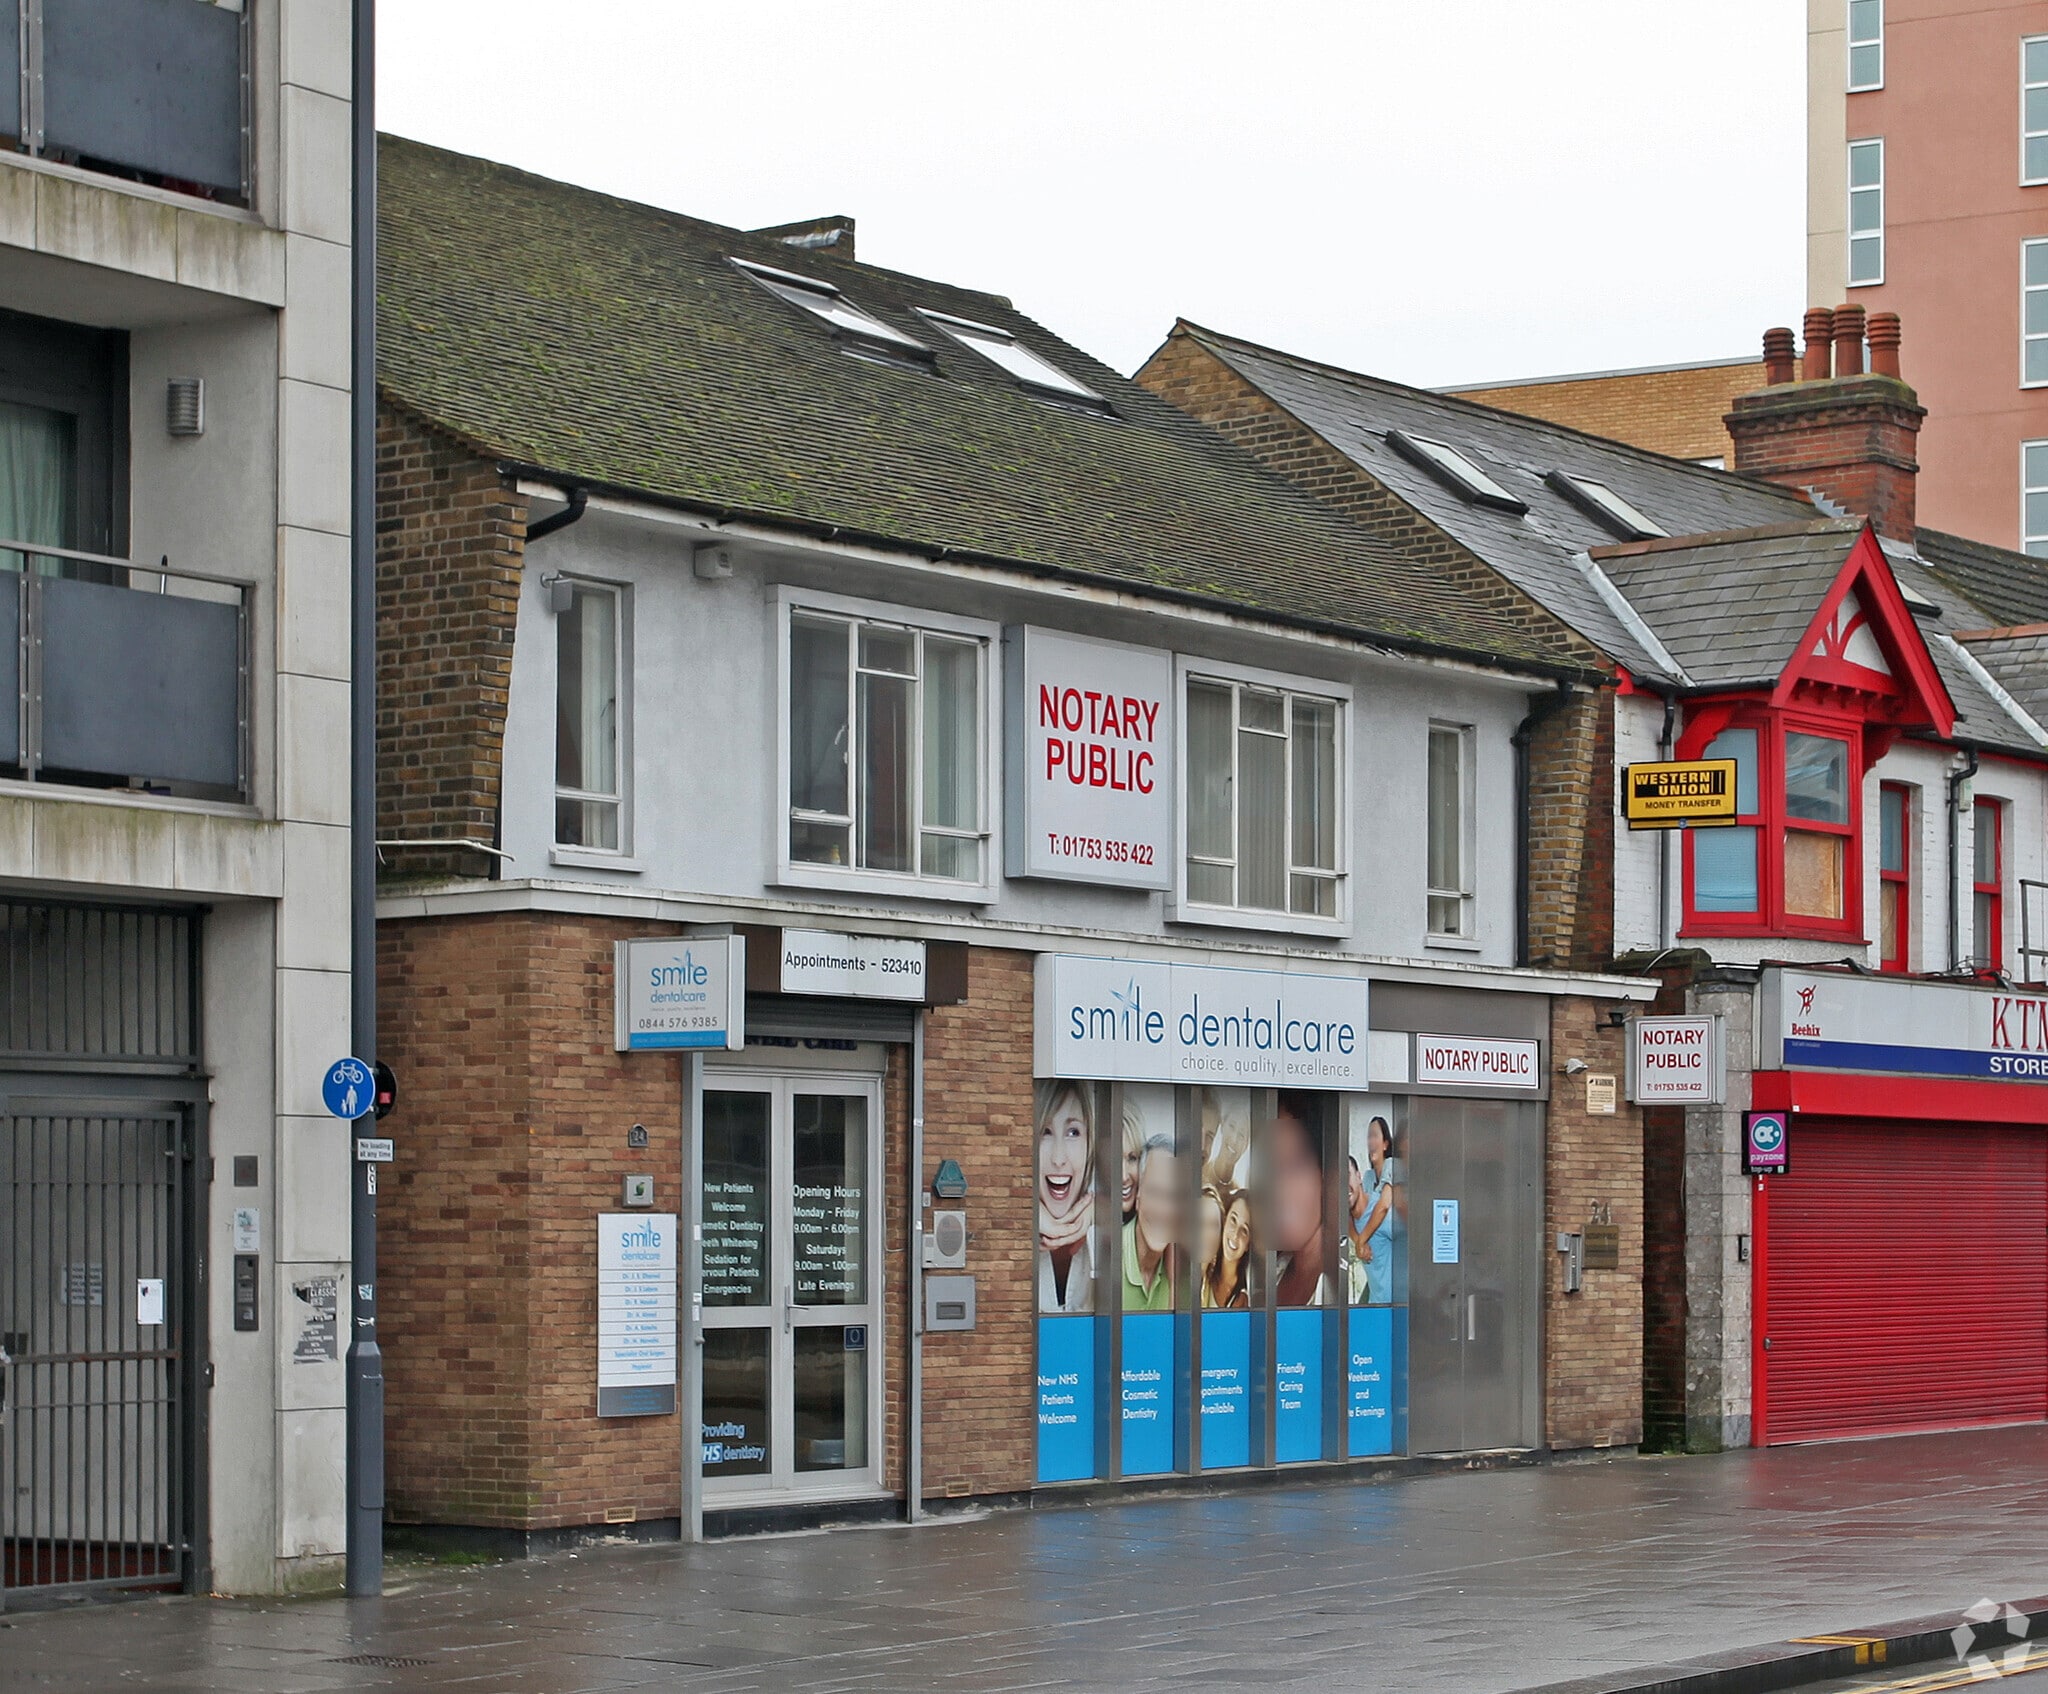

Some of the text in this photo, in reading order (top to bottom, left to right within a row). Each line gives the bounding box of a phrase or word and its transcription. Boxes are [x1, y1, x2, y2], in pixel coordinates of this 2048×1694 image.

[1040, 684, 1160, 743] NOTARY
[1046, 738, 1154, 795] PUBLIC
[1635, 771, 1710, 785] WESTERN
[1658, 783, 1710, 796] UNION
[1645, 799, 1722, 809] MONEY TRANSFER
[1048, 833, 1153, 866] T: 01753 535 422
[651, 950, 708, 987] smile
[785, 951, 866, 971] Appointments
[881, 958, 922, 976] 523410
[650, 989, 706, 1003] dentalcare
[639, 1016, 718, 1029] 0844 576 9385
[1070, 986, 1355, 1055] smile dentalcare
[1643, 1029, 1704, 1045] NOTARY
[1182, 1052, 1228, 1071] choice.
[1287, 1059, 1354, 1077] excellence.
[1425, 1048, 1529, 1074] NOTARY PUBLIC
[1646, 1053, 1702, 1068] PUBLIC
[1654, 1083, 1674, 1091] 01753
[1676, 1083, 1688, 1091] 535
[1690, 1083, 1702, 1091] 422
[1751, 1154, 1784, 1163] payzone
[704, 1182, 754, 1193] New Patients
[793, 1184, 861, 1200] Opening Hours
[711, 1201, 747, 1212] Welcome
[793, 1207, 825, 1219] Monday
[835, 1206, 859, 1220] Friday
[730, 1220, 764, 1232] Dentistry
[622, 1219, 661, 1248] smile
[701, 1237, 758, 1249] eeth Whitening
[806, 1244, 848, 1256] Saturdays
[704, 1254, 752, 1264] Sedation for
[729, 1267, 759, 1277] Patients
[704, 1284, 752, 1295] Emergencies
[798, 1280, 855, 1292] Late Evenings
[1353, 1354, 1372, 1366] Open
[1201, 1368, 1239, 1379] mergency
[1277, 1362, 1306, 1375] Friendly
[1038, 1373, 1079, 1386] New NHS
[1122, 1388, 1159, 1400] Cosmetic
[1279, 1381, 1304, 1394] Caring
[1355, 1388, 1369, 1400] and
[1042, 1394, 1074, 1405] Patients
[1280, 1399, 1302, 1409] Team
[1123, 1408, 1158, 1420] Dentistry
[1200, 1402, 1235, 1414] Available
[1355, 1405, 1386, 1418] Evenings
[1039, 1412, 1078, 1424] Welcome
[702, 1445, 766, 1462] HS dentistry
